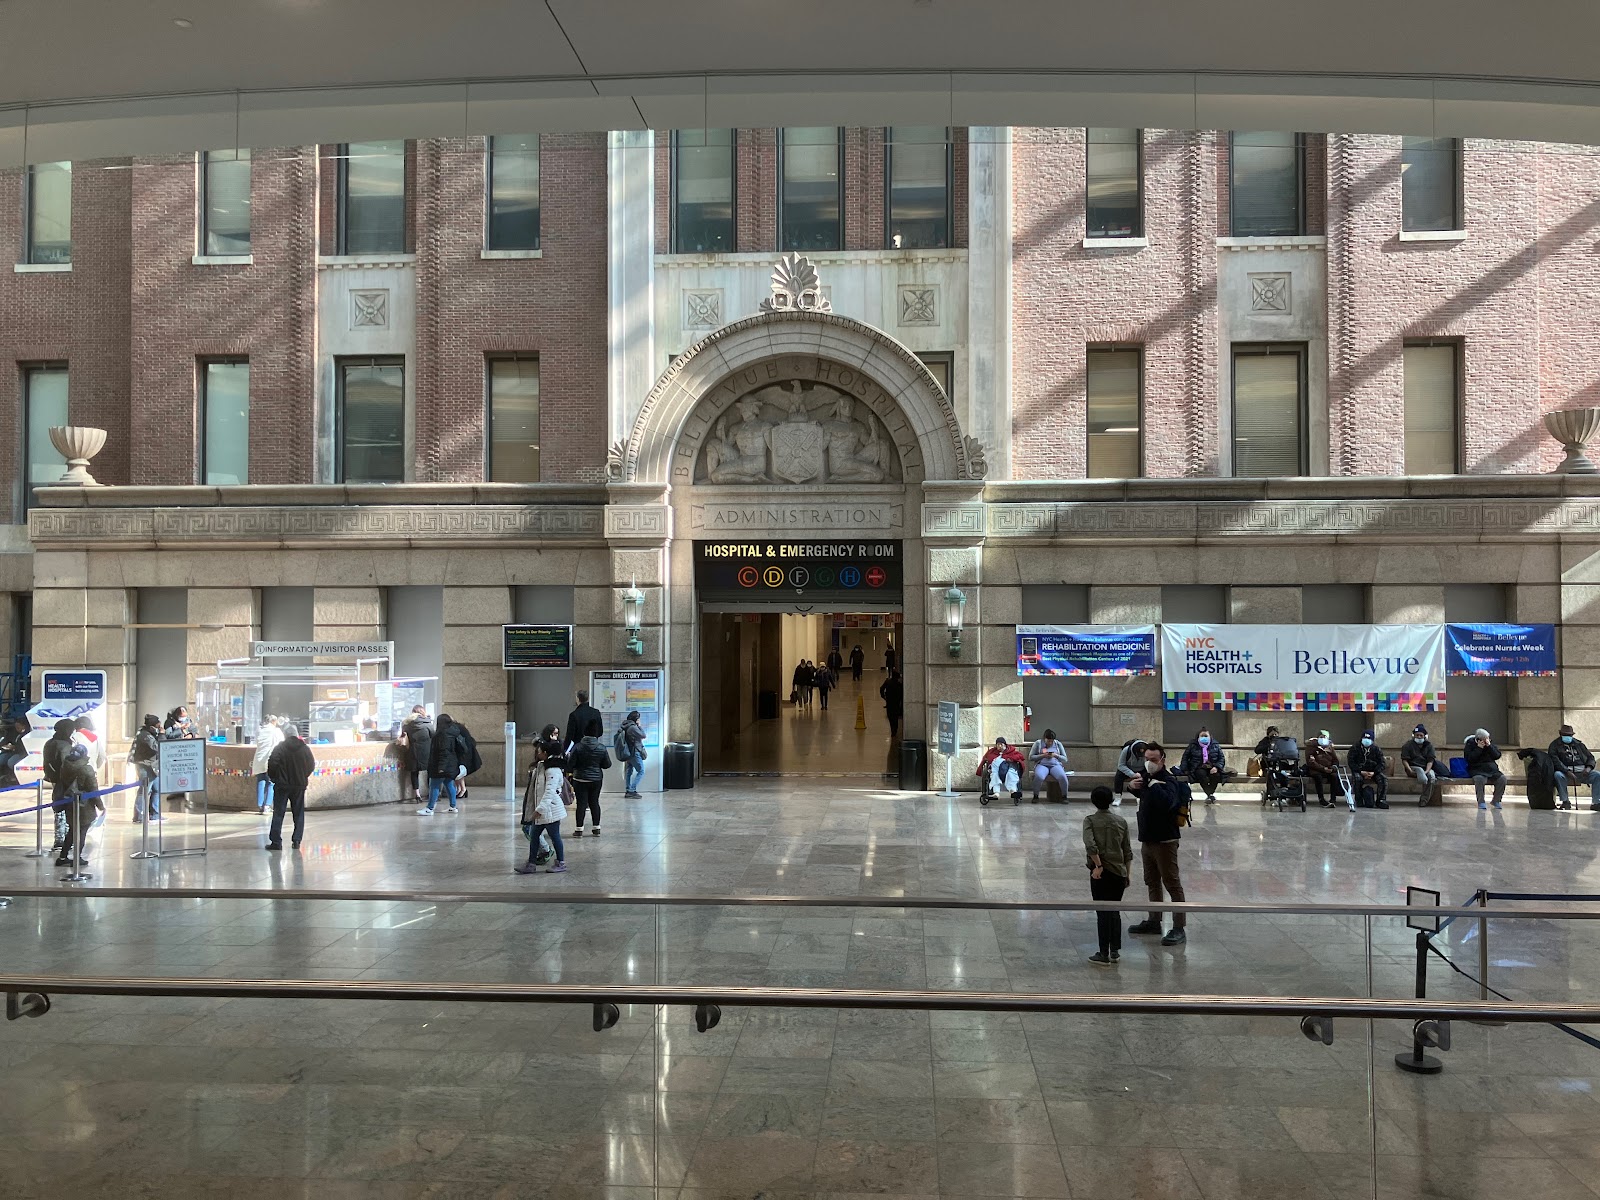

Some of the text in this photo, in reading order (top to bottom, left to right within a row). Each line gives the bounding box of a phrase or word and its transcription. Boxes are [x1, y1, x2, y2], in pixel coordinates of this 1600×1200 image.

[674, 357, 922, 478] BELLEVUE HOSPITAL
[713, 509, 882, 524] ADMINISTRATION
[704, 544, 763, 558] HOSPITAL
[766, 544, 777, 558] &
[780, 544, 854, 557] EMERGENCY
[1186, 637, 1215, 649] NYC
[1186, 662, 1262, 674] HOSPITALS
[1292, 650, 1420, 675] Bellevue
